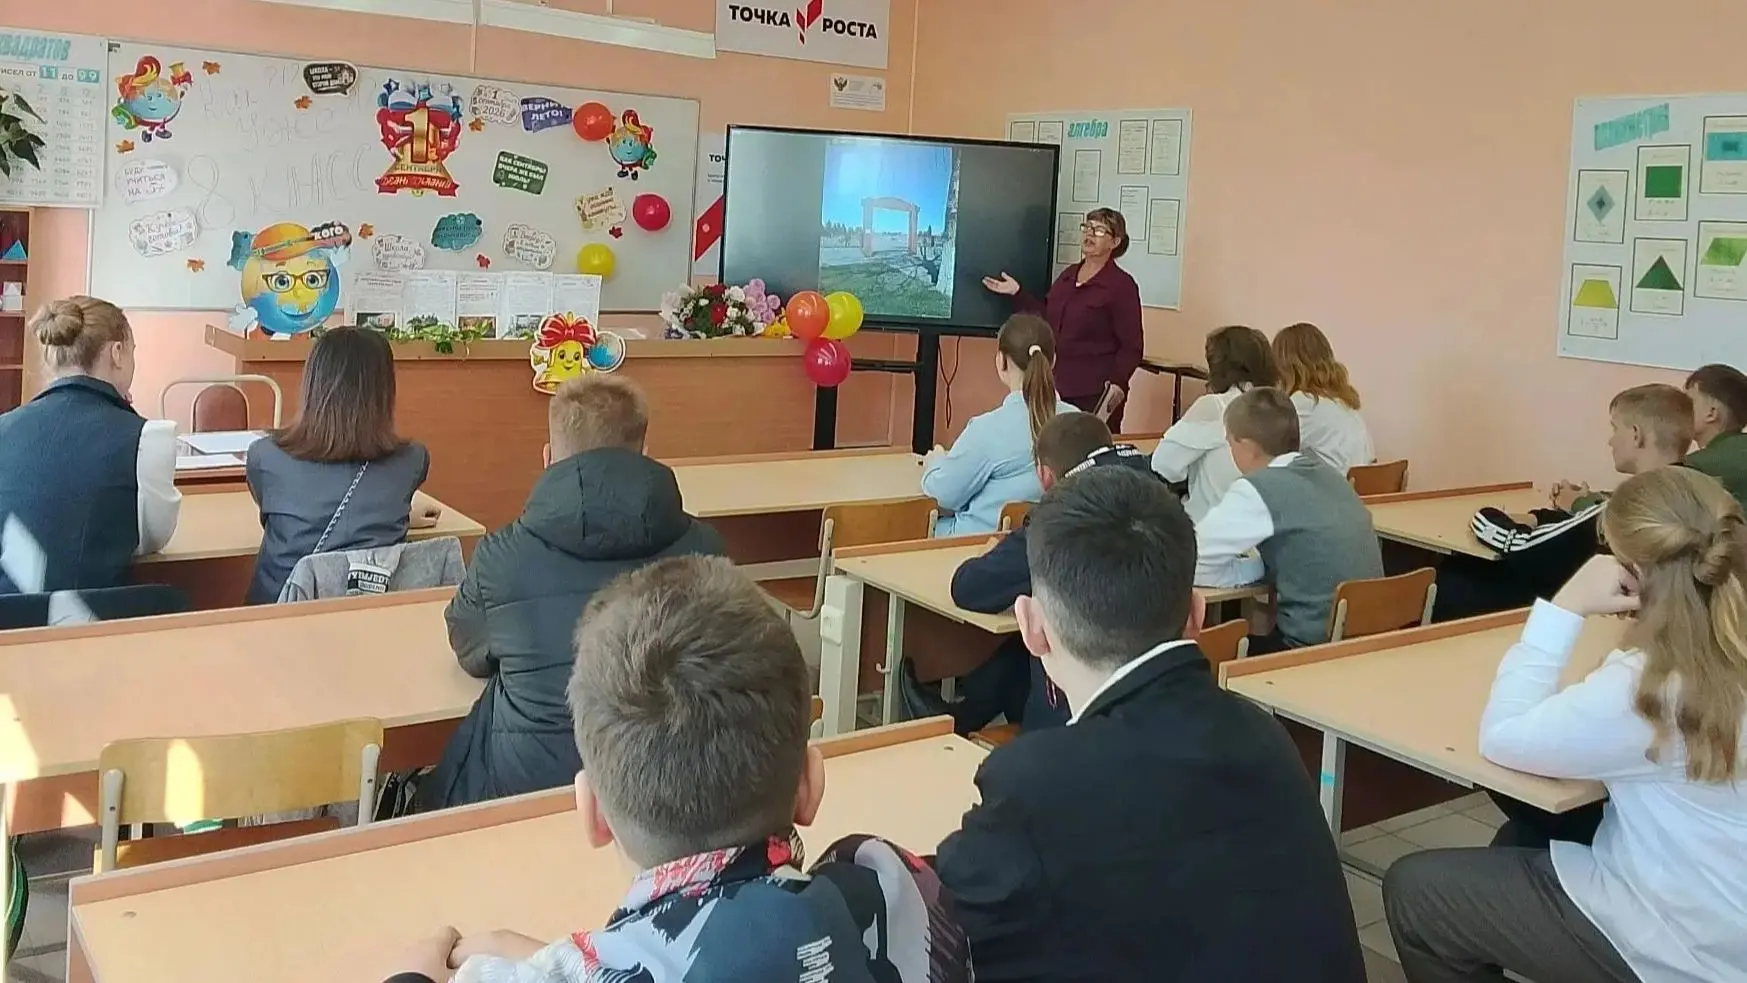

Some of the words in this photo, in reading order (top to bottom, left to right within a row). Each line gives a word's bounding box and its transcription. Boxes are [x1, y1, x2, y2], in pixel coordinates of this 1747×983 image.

[728, 4, 791, 28] ТОЧКА
[822, 17, 878, 39] РОСТА
[531, 109, 563, 121] ЛЕТО!
[1067, 118, 1109, 139] алгебра
[404, 107, 430, 164] 1
